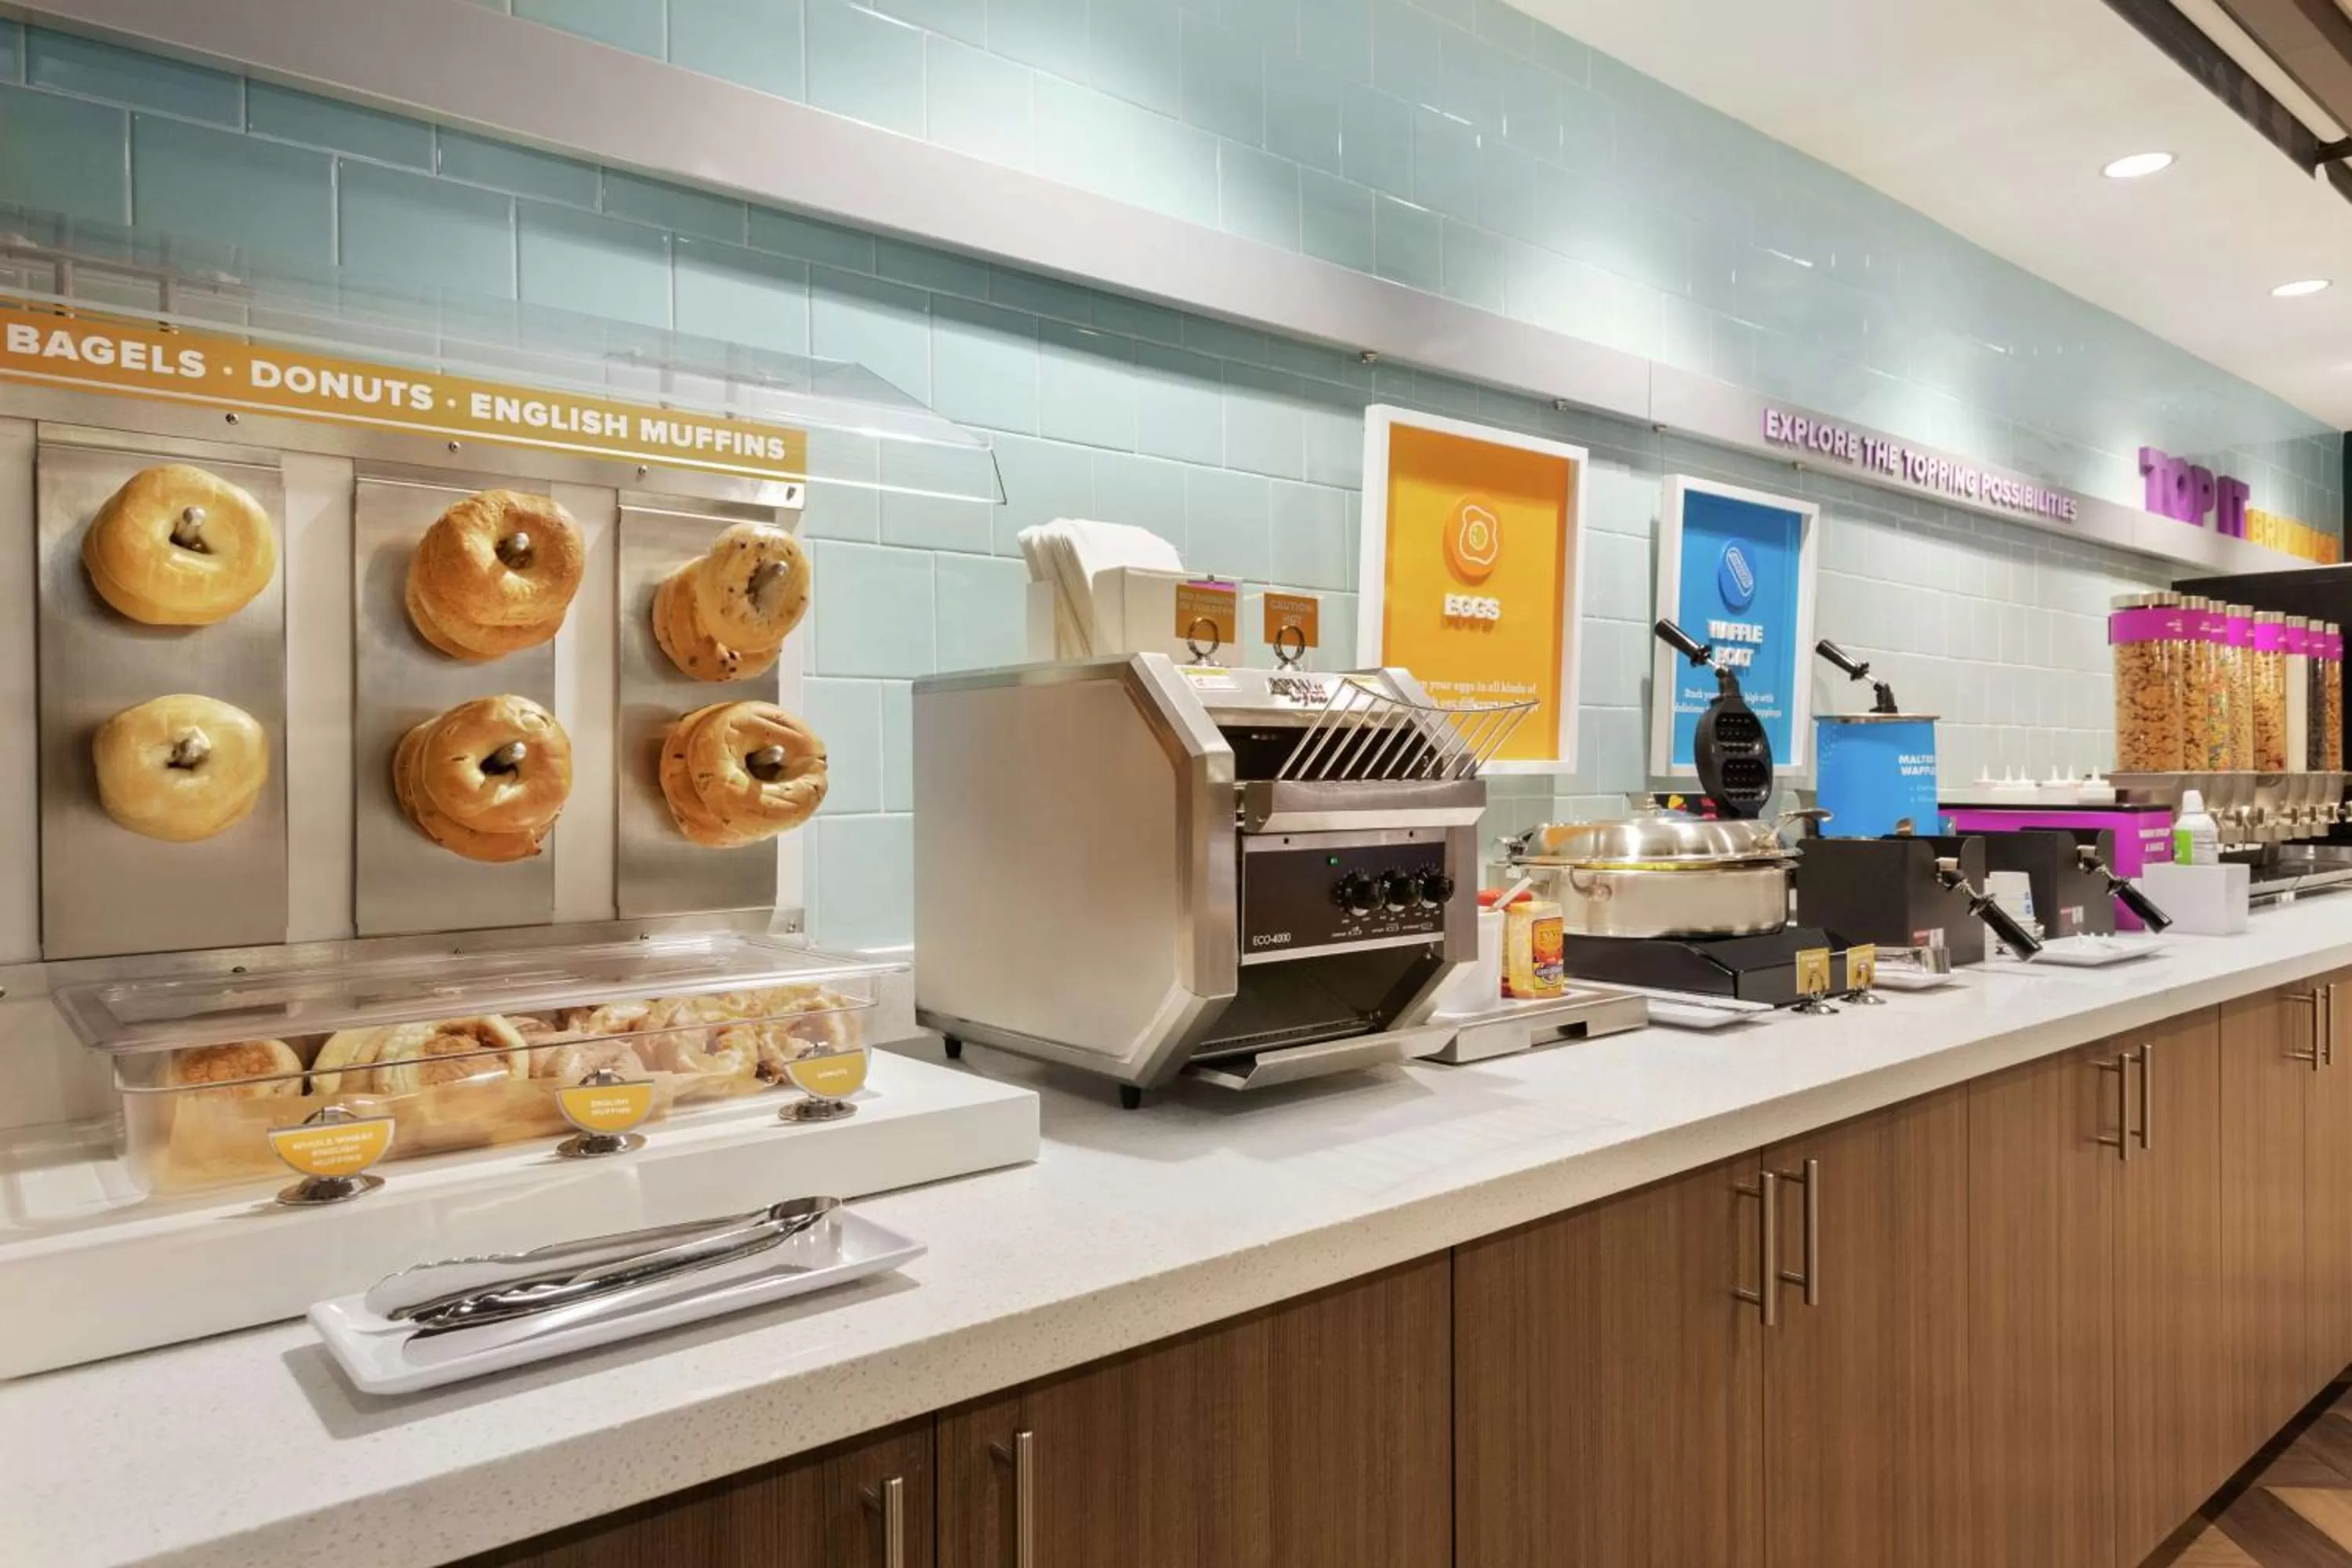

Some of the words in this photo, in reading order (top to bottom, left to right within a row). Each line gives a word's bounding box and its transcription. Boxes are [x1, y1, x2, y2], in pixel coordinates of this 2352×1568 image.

[6, 323, 207, 378] BAGELS
[250, 359, 434, 411] DONUTS
[470, 392, 627, 437] ENGLISH
[640, 417, 786, 460] MUFFINS
[1762, 408, 1858, 459] EXPLORE
[1863, 436, 1898, 470] THE
[1902, 448, 1976, 494] TOPPING
[1980, 473, 2077, 521] POSSIBILITIES
[2139, 447, 2215, 528] TOP
[2216, 475, 2250, 540] IT
[1445, 593, 1501, 621] EGGS
